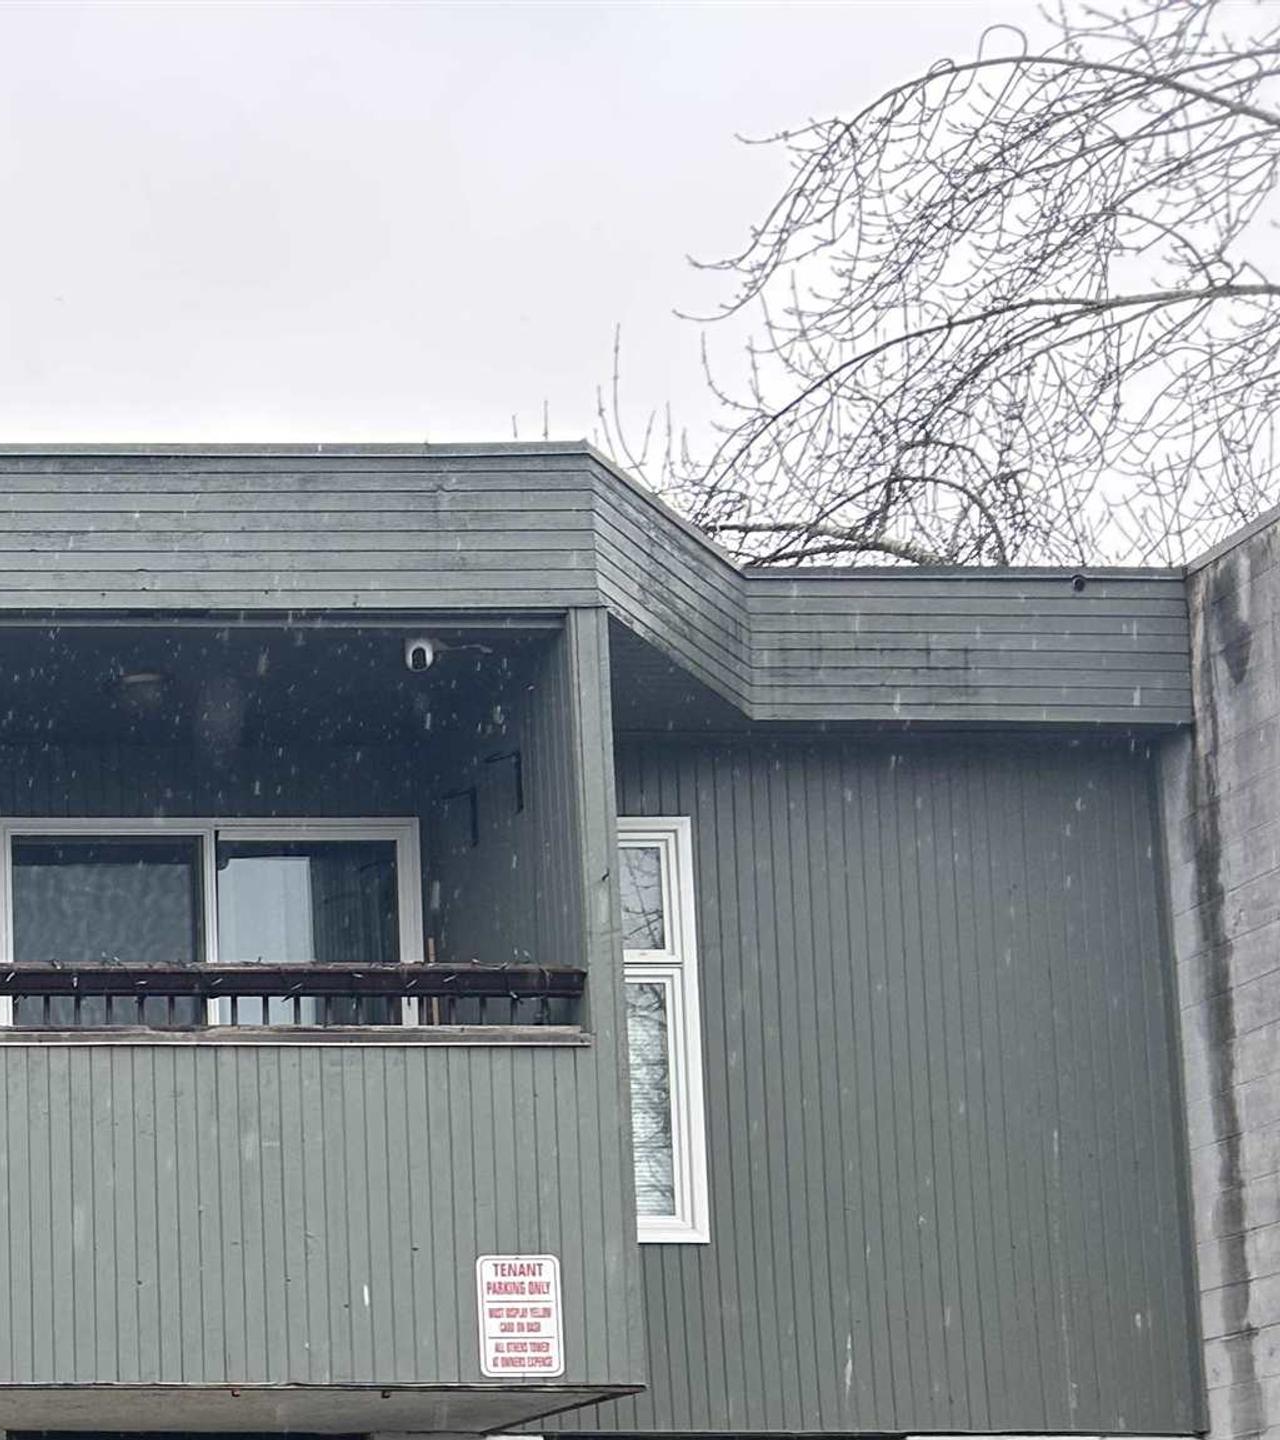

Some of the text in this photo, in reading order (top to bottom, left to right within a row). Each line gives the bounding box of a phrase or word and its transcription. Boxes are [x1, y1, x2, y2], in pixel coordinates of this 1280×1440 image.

[492, 1263, 544, 1277] TENANT
[486, 1281, 551, 1295] PARKING ONLY
